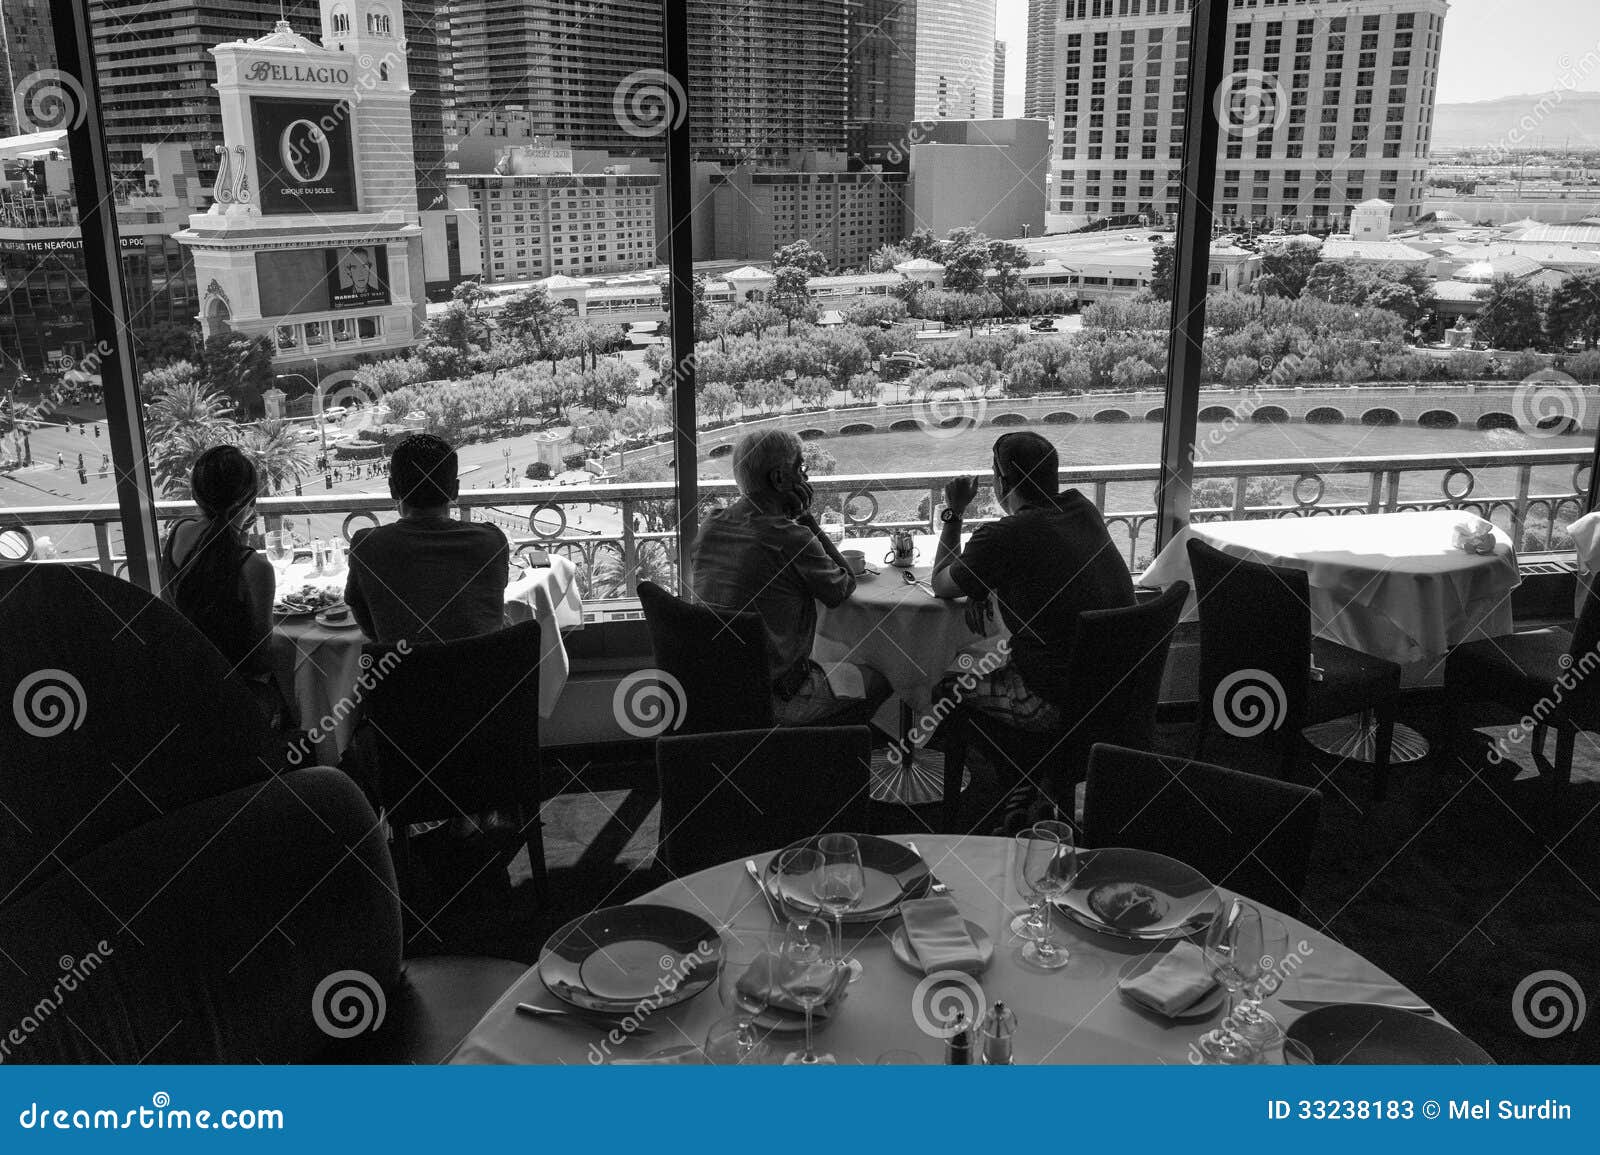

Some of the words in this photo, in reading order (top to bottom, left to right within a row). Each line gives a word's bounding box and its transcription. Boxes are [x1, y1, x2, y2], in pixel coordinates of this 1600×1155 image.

[245, 61, 349, 84] BELLAGIO
[280, 119, 331, 182] O
[26, 242, 43, 251] THE
